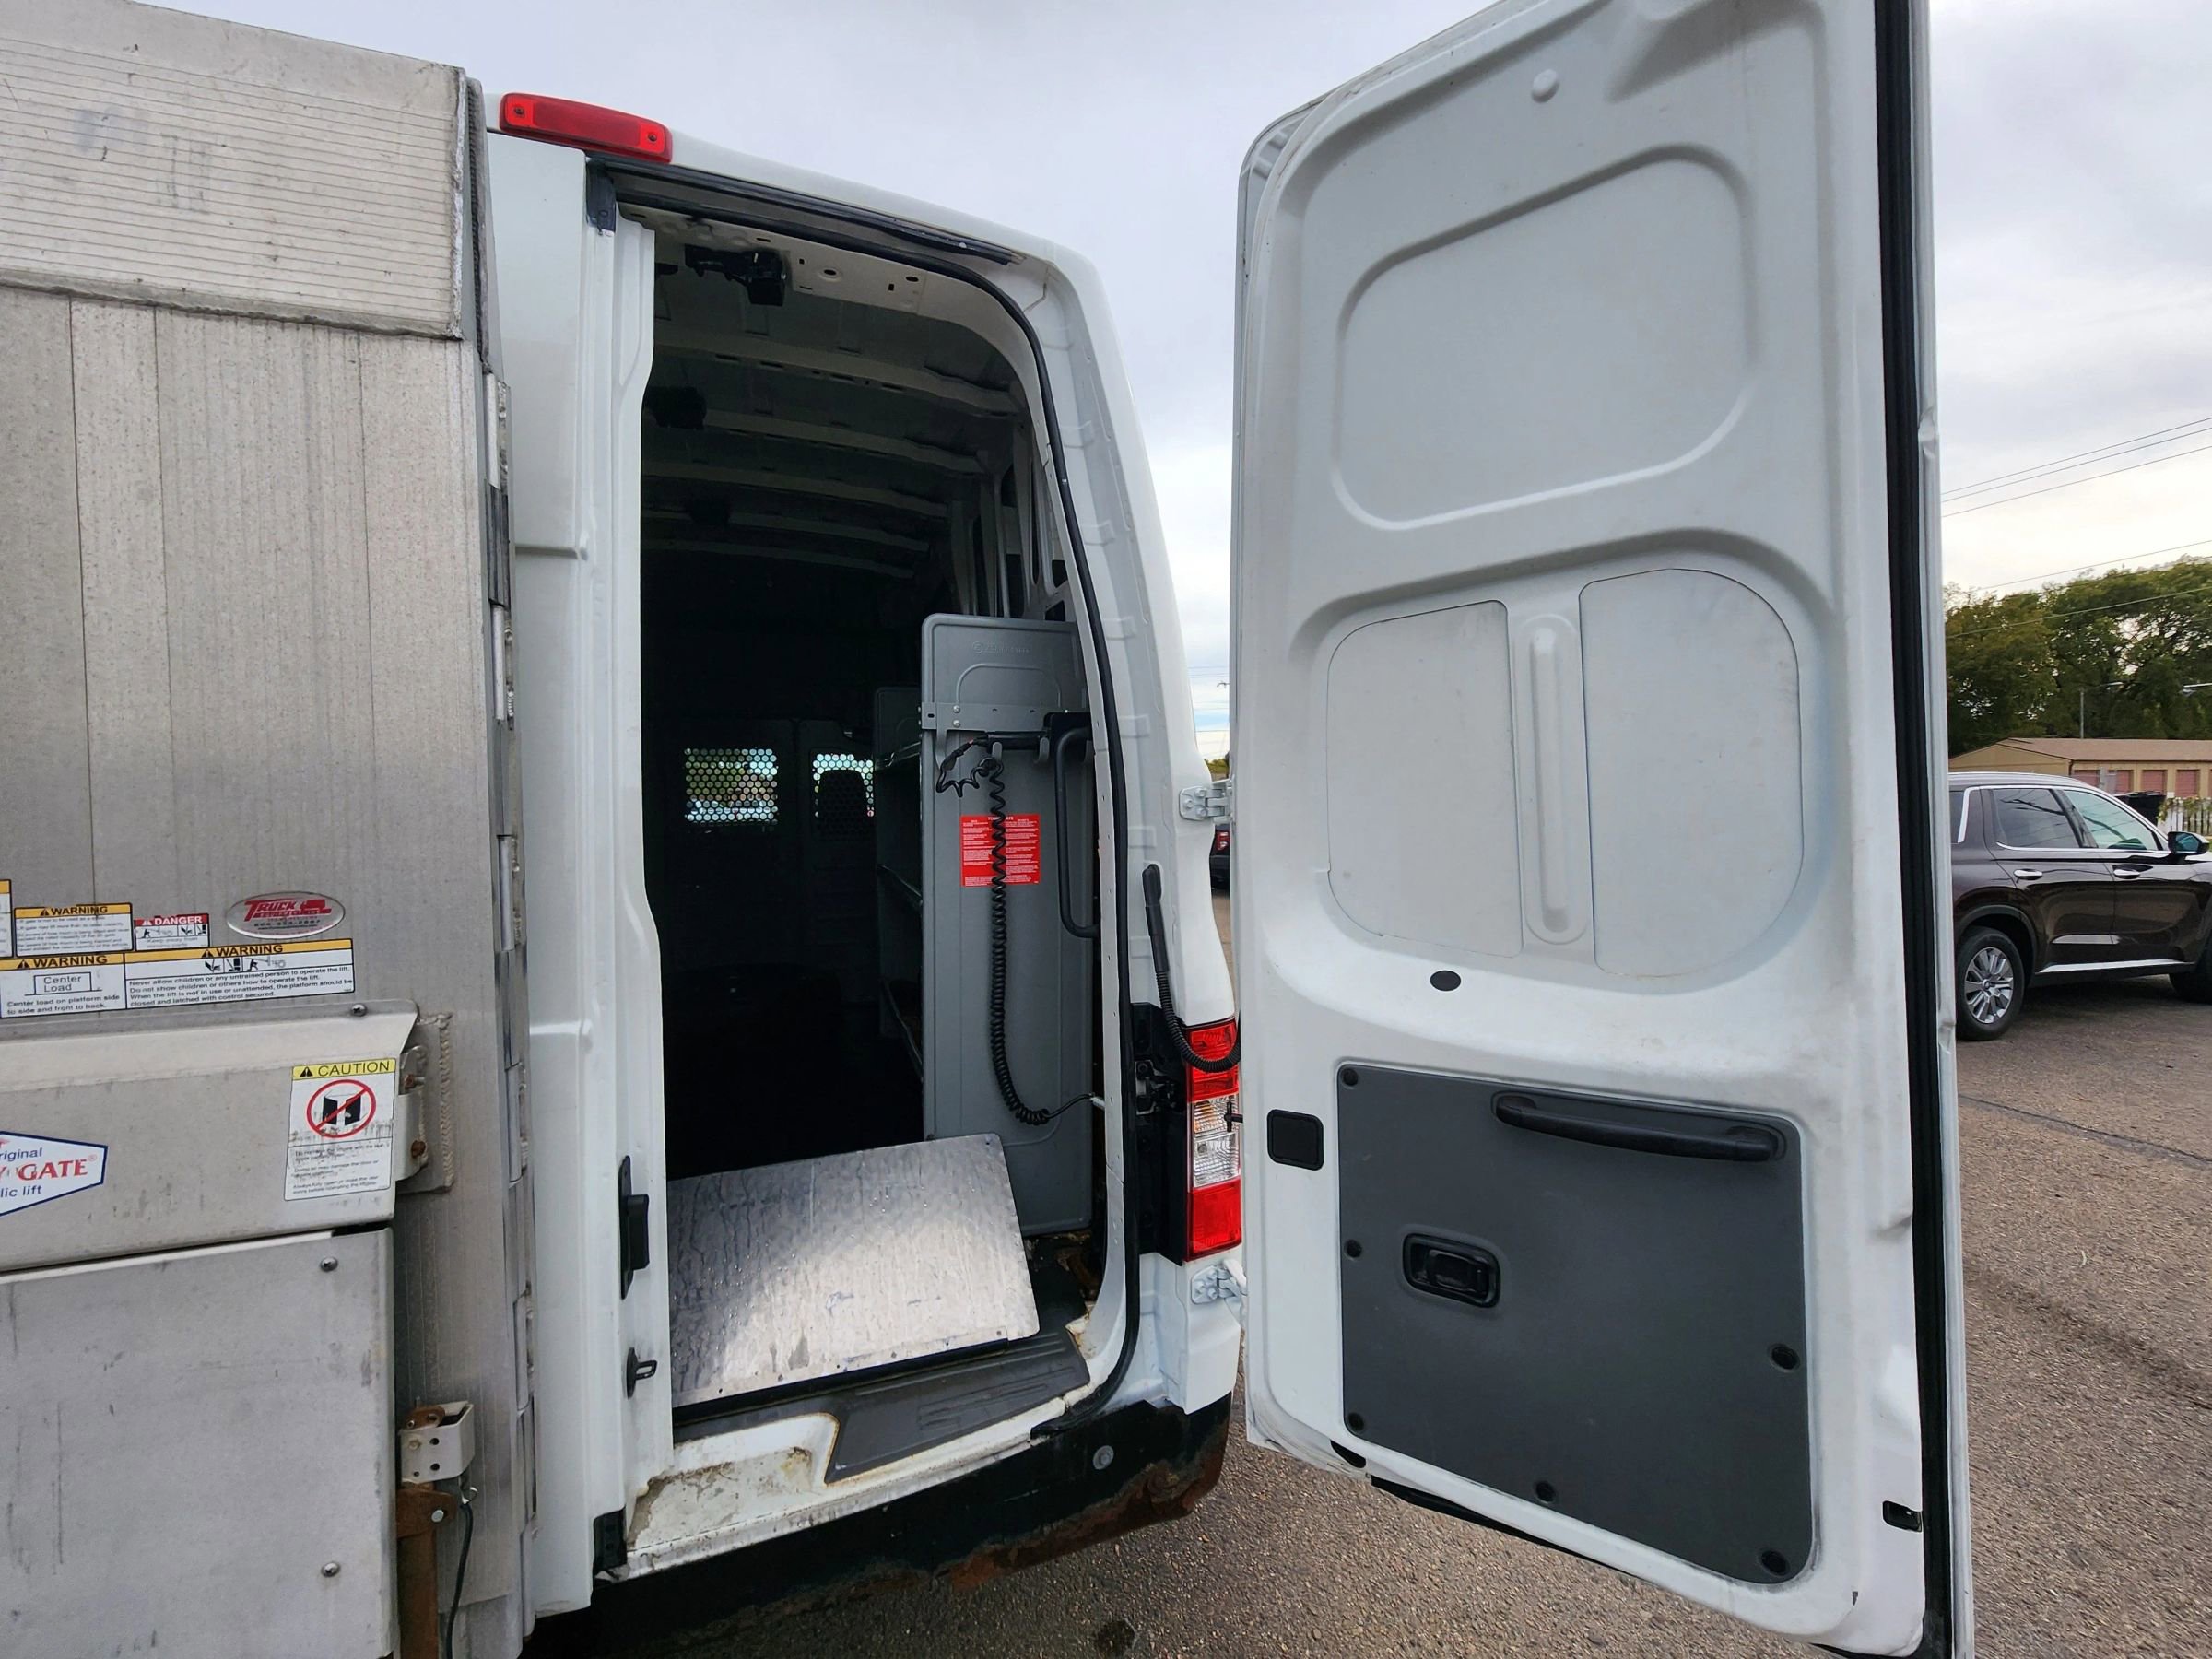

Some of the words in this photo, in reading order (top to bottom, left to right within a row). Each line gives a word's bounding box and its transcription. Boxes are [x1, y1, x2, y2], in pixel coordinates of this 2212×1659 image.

[51, 906, 108, 916] WARNING
[244, 898, 297, 922] TRUCK
[154, 916, 202, 925] DANGER
[216, 944, 284, 957] WARNING
[33, 955, 108, 968] WARNING
[43, 975, 82, 985] Center
[43, 983, 73, 993] Load
[68, 995, 101, 1006] platform
[317, 1060, 390, 1077] CAUTION
[18, 1159, 88, 1181] GATE
[22, 1185, 42, 1195] lift
